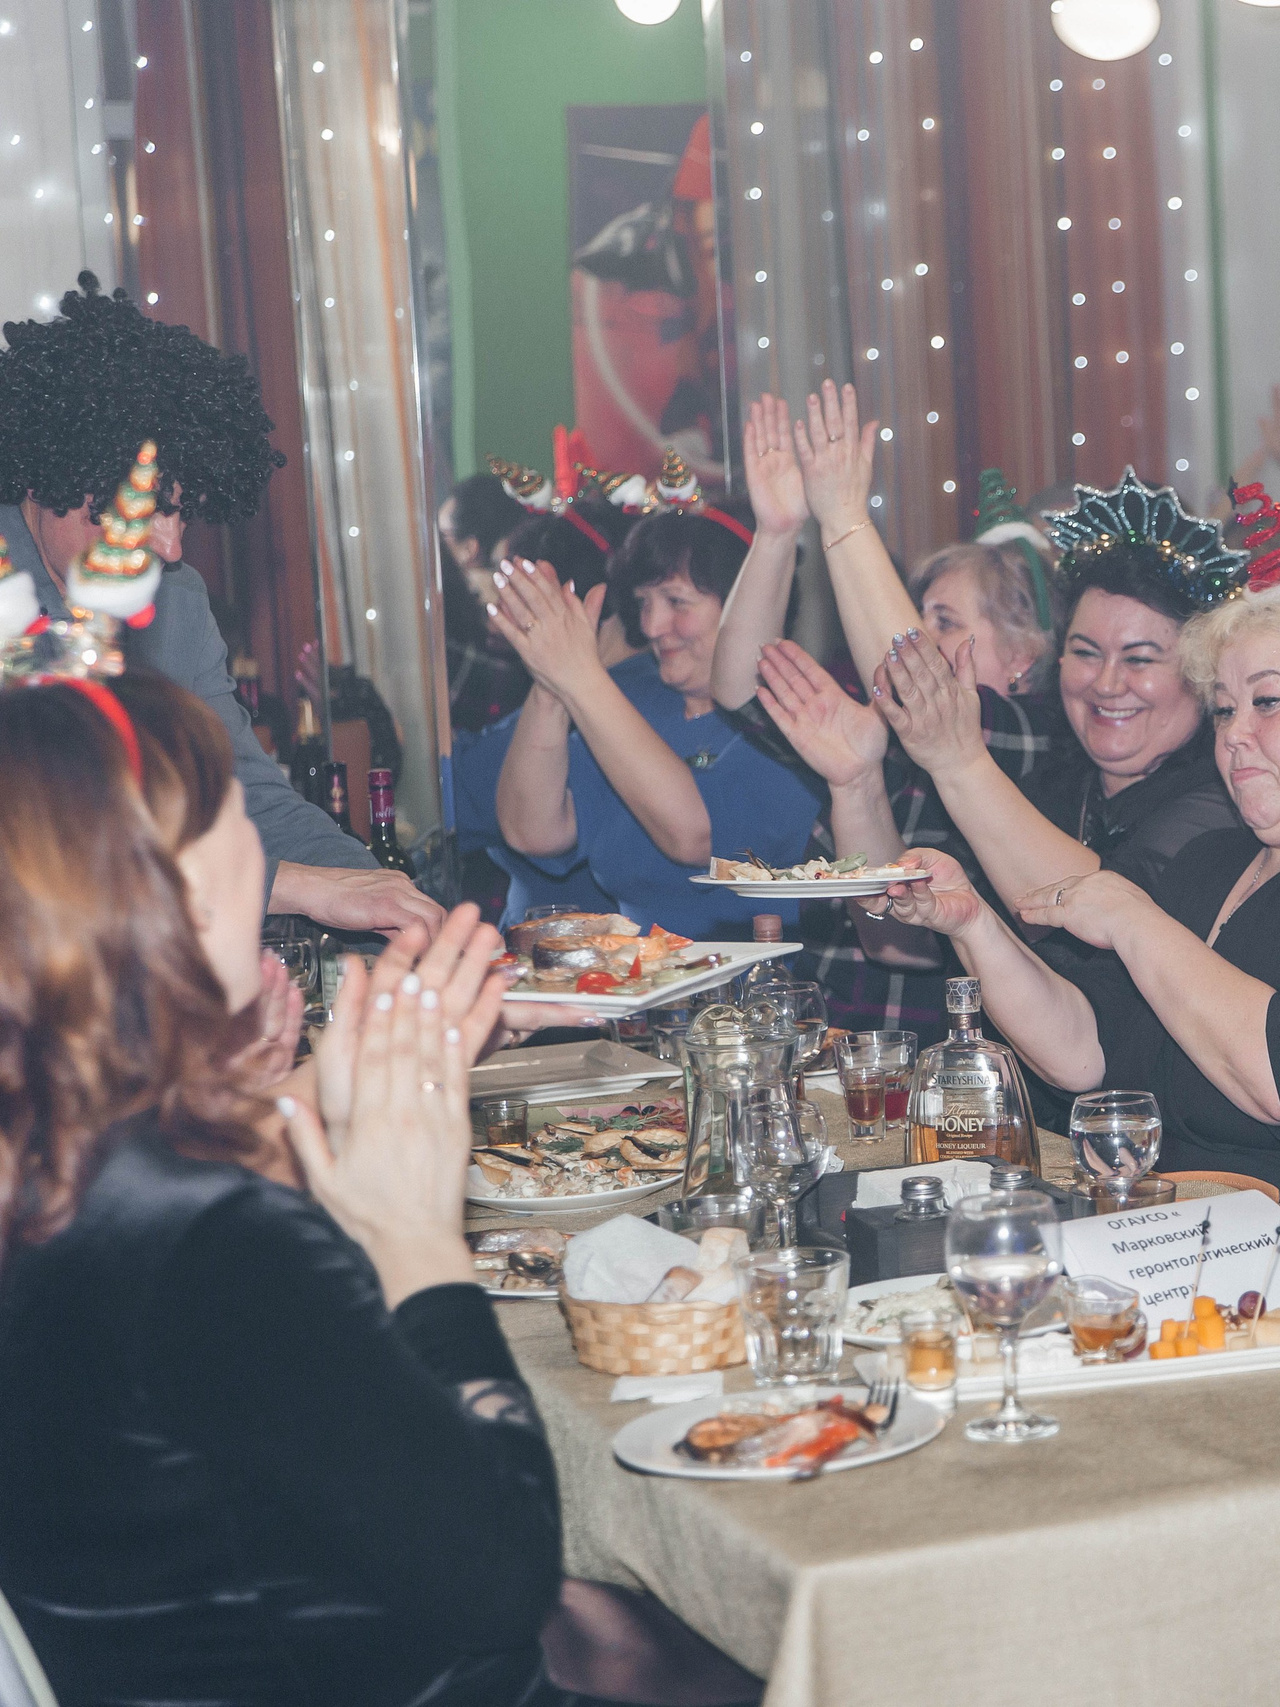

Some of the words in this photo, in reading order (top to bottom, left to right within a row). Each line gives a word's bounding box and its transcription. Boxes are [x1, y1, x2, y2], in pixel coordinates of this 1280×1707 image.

[935, 1115, 986, 1132] HONEY
[1108, 1211, 1168, 1230] ОГАУСО
[1112, 1223, 1209, 1254] Марковский
[1129, 1234, 1275, 1280] геронтологический
